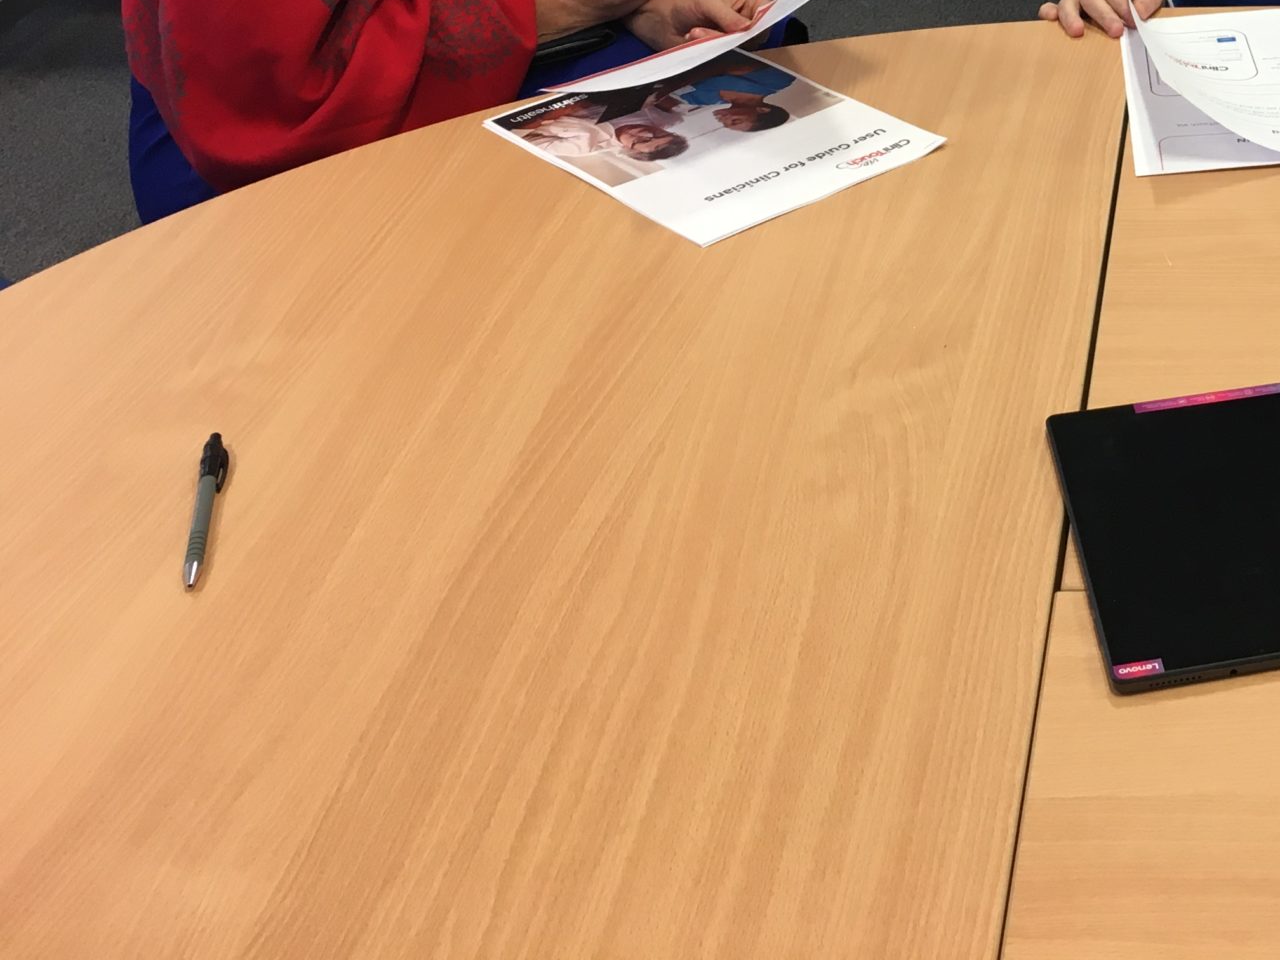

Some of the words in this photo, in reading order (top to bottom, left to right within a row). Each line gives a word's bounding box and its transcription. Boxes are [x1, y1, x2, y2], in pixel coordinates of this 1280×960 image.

[852, 128, 887, 145] User
[806, 142, 850, 162] Guide
[782, 160, 807, 173] for
[703, 170, 781, 202] Clinicians
[1118, 662, 1160, 675] Lenovo
